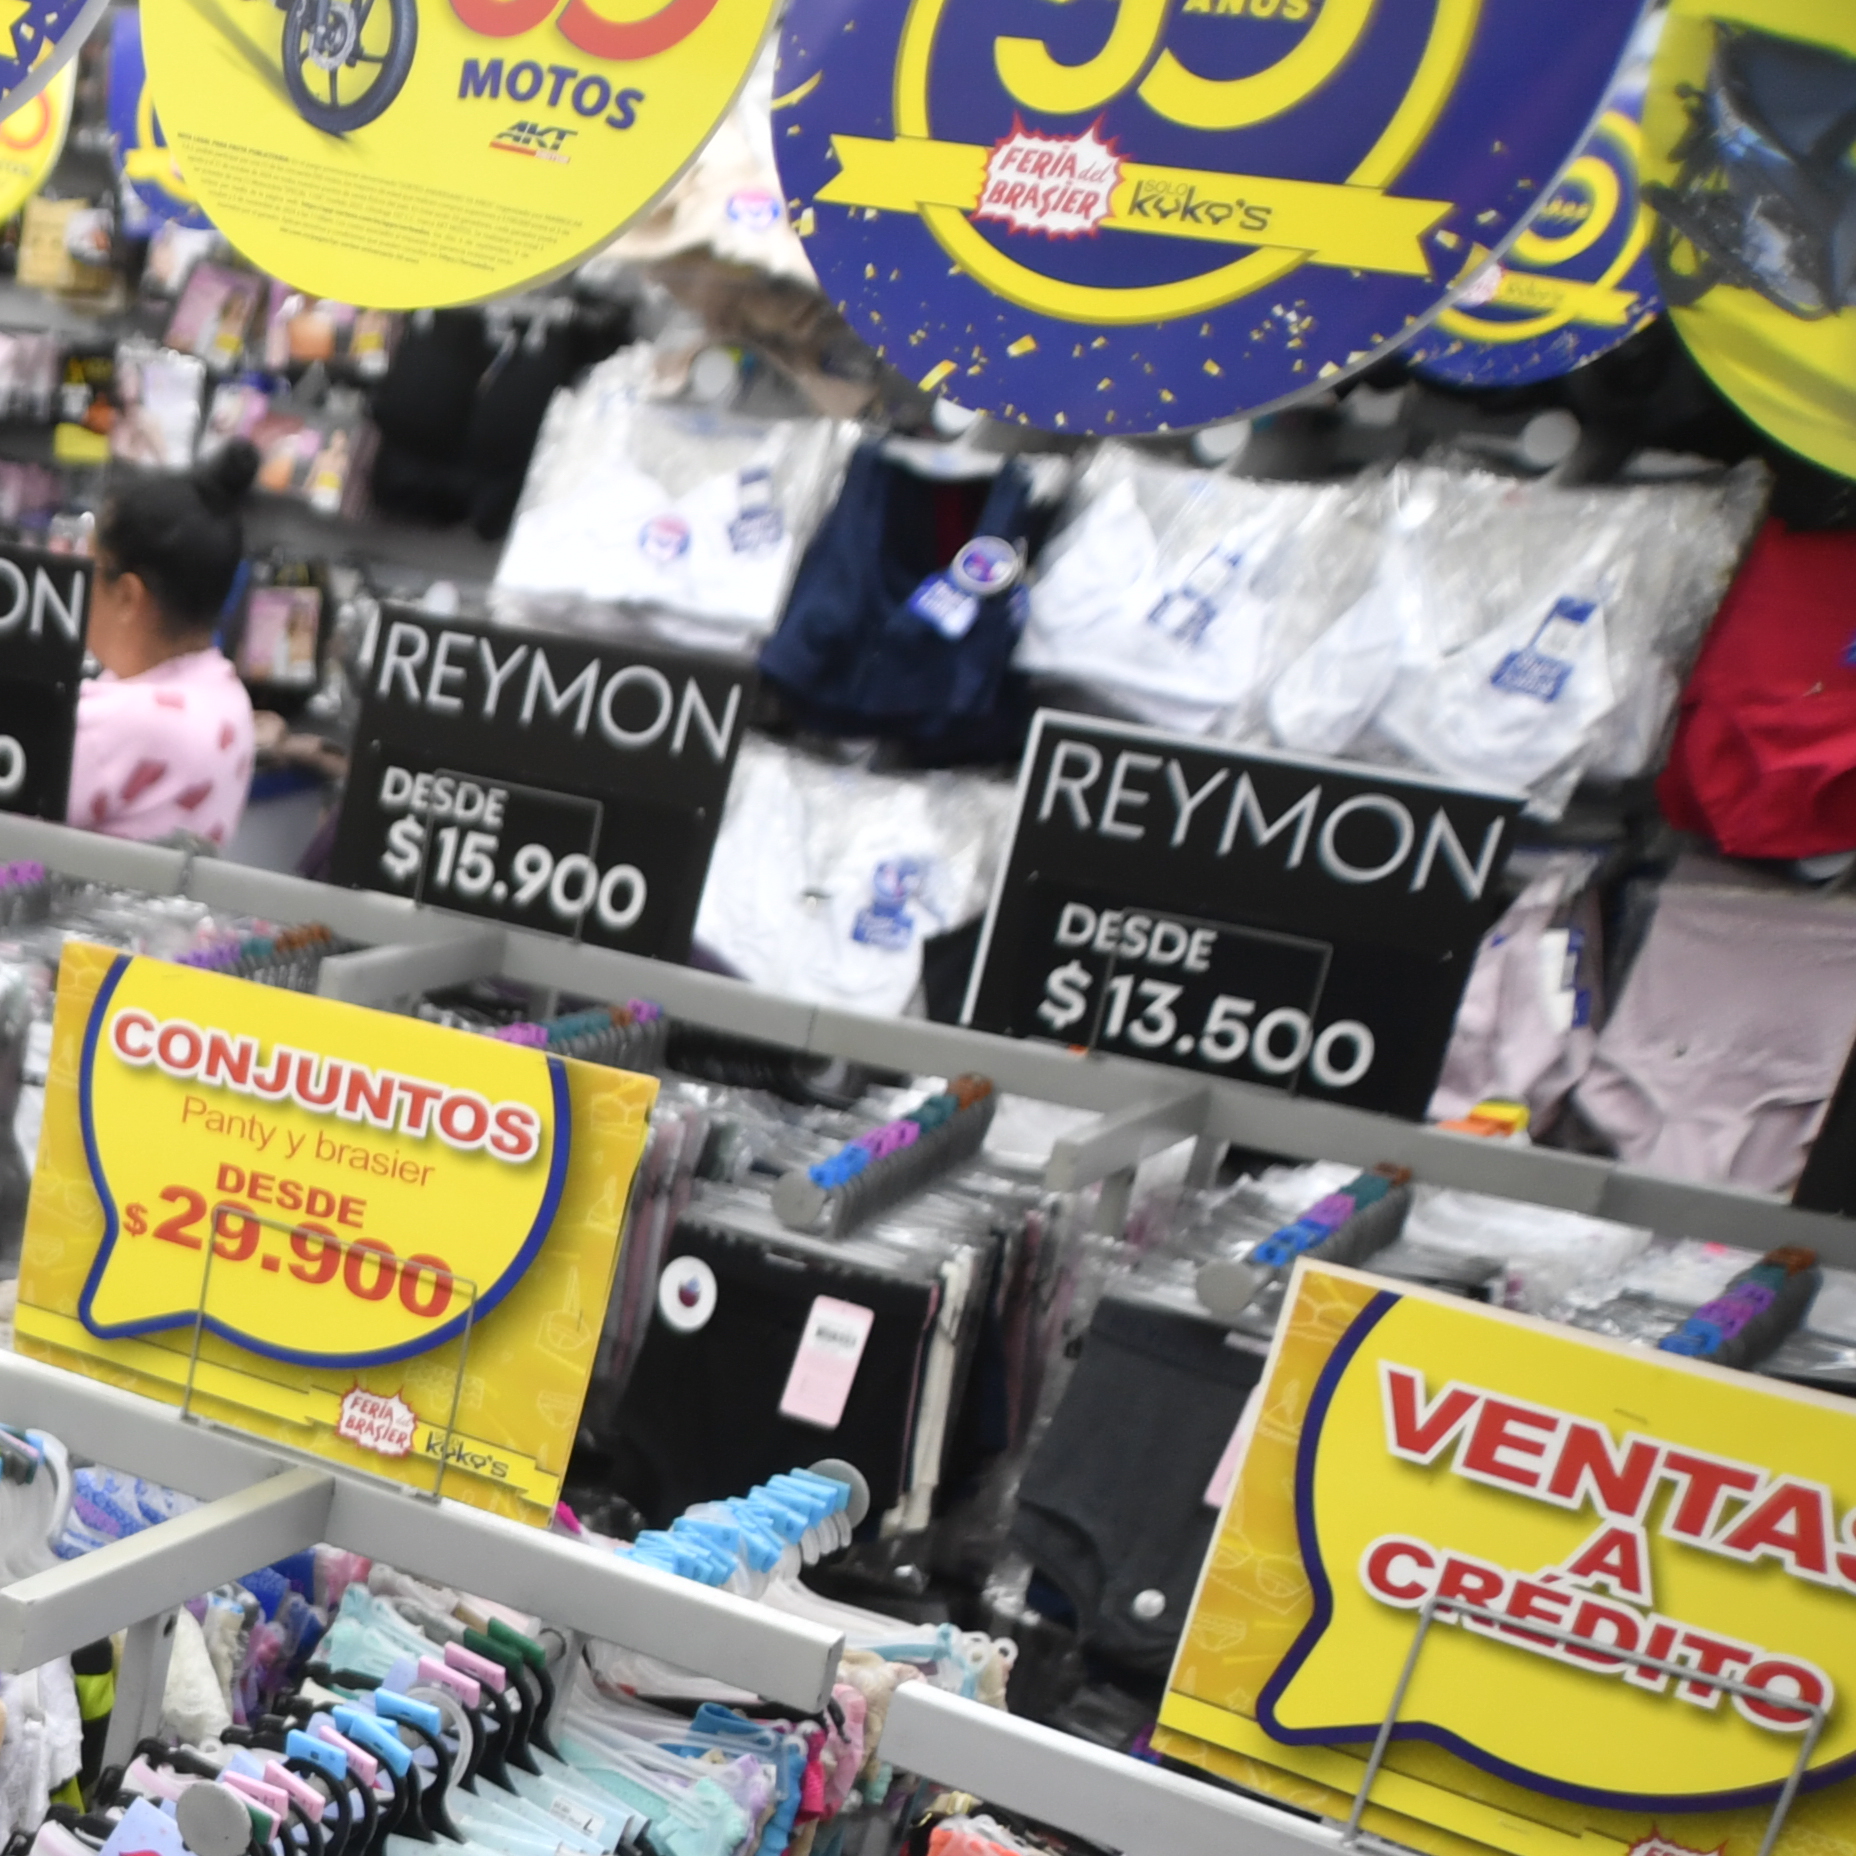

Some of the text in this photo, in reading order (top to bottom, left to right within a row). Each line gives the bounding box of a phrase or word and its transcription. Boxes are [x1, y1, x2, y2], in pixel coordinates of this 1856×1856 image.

[458, 56, 645, 130] MOTOS
[492, 119, 579, 152] AKT
[1078, 161, 1110, 183] del
[1144, 180, 1190, 194] SOLO
[378, 620, 742, 764] REYMON
[379, 765, 509, 831] DESDE
[1036, 739, 1507, 902] REYMON
[1054, 902, 1218, 974] DESDE
[110, 1012, 541, 1160] CONJUNTOS
[180, 1095, 436, 1188] Panty y brasier
[215, 1163, 368, 1229] DESDE
[123, 1183, 455, 1319] $29.900
[1386, 1367, 1856, 1592] VENTA
[1571, 1524, 1646, 1597] A
[1366, 1540, 1827, 1727] CRÉDITO
